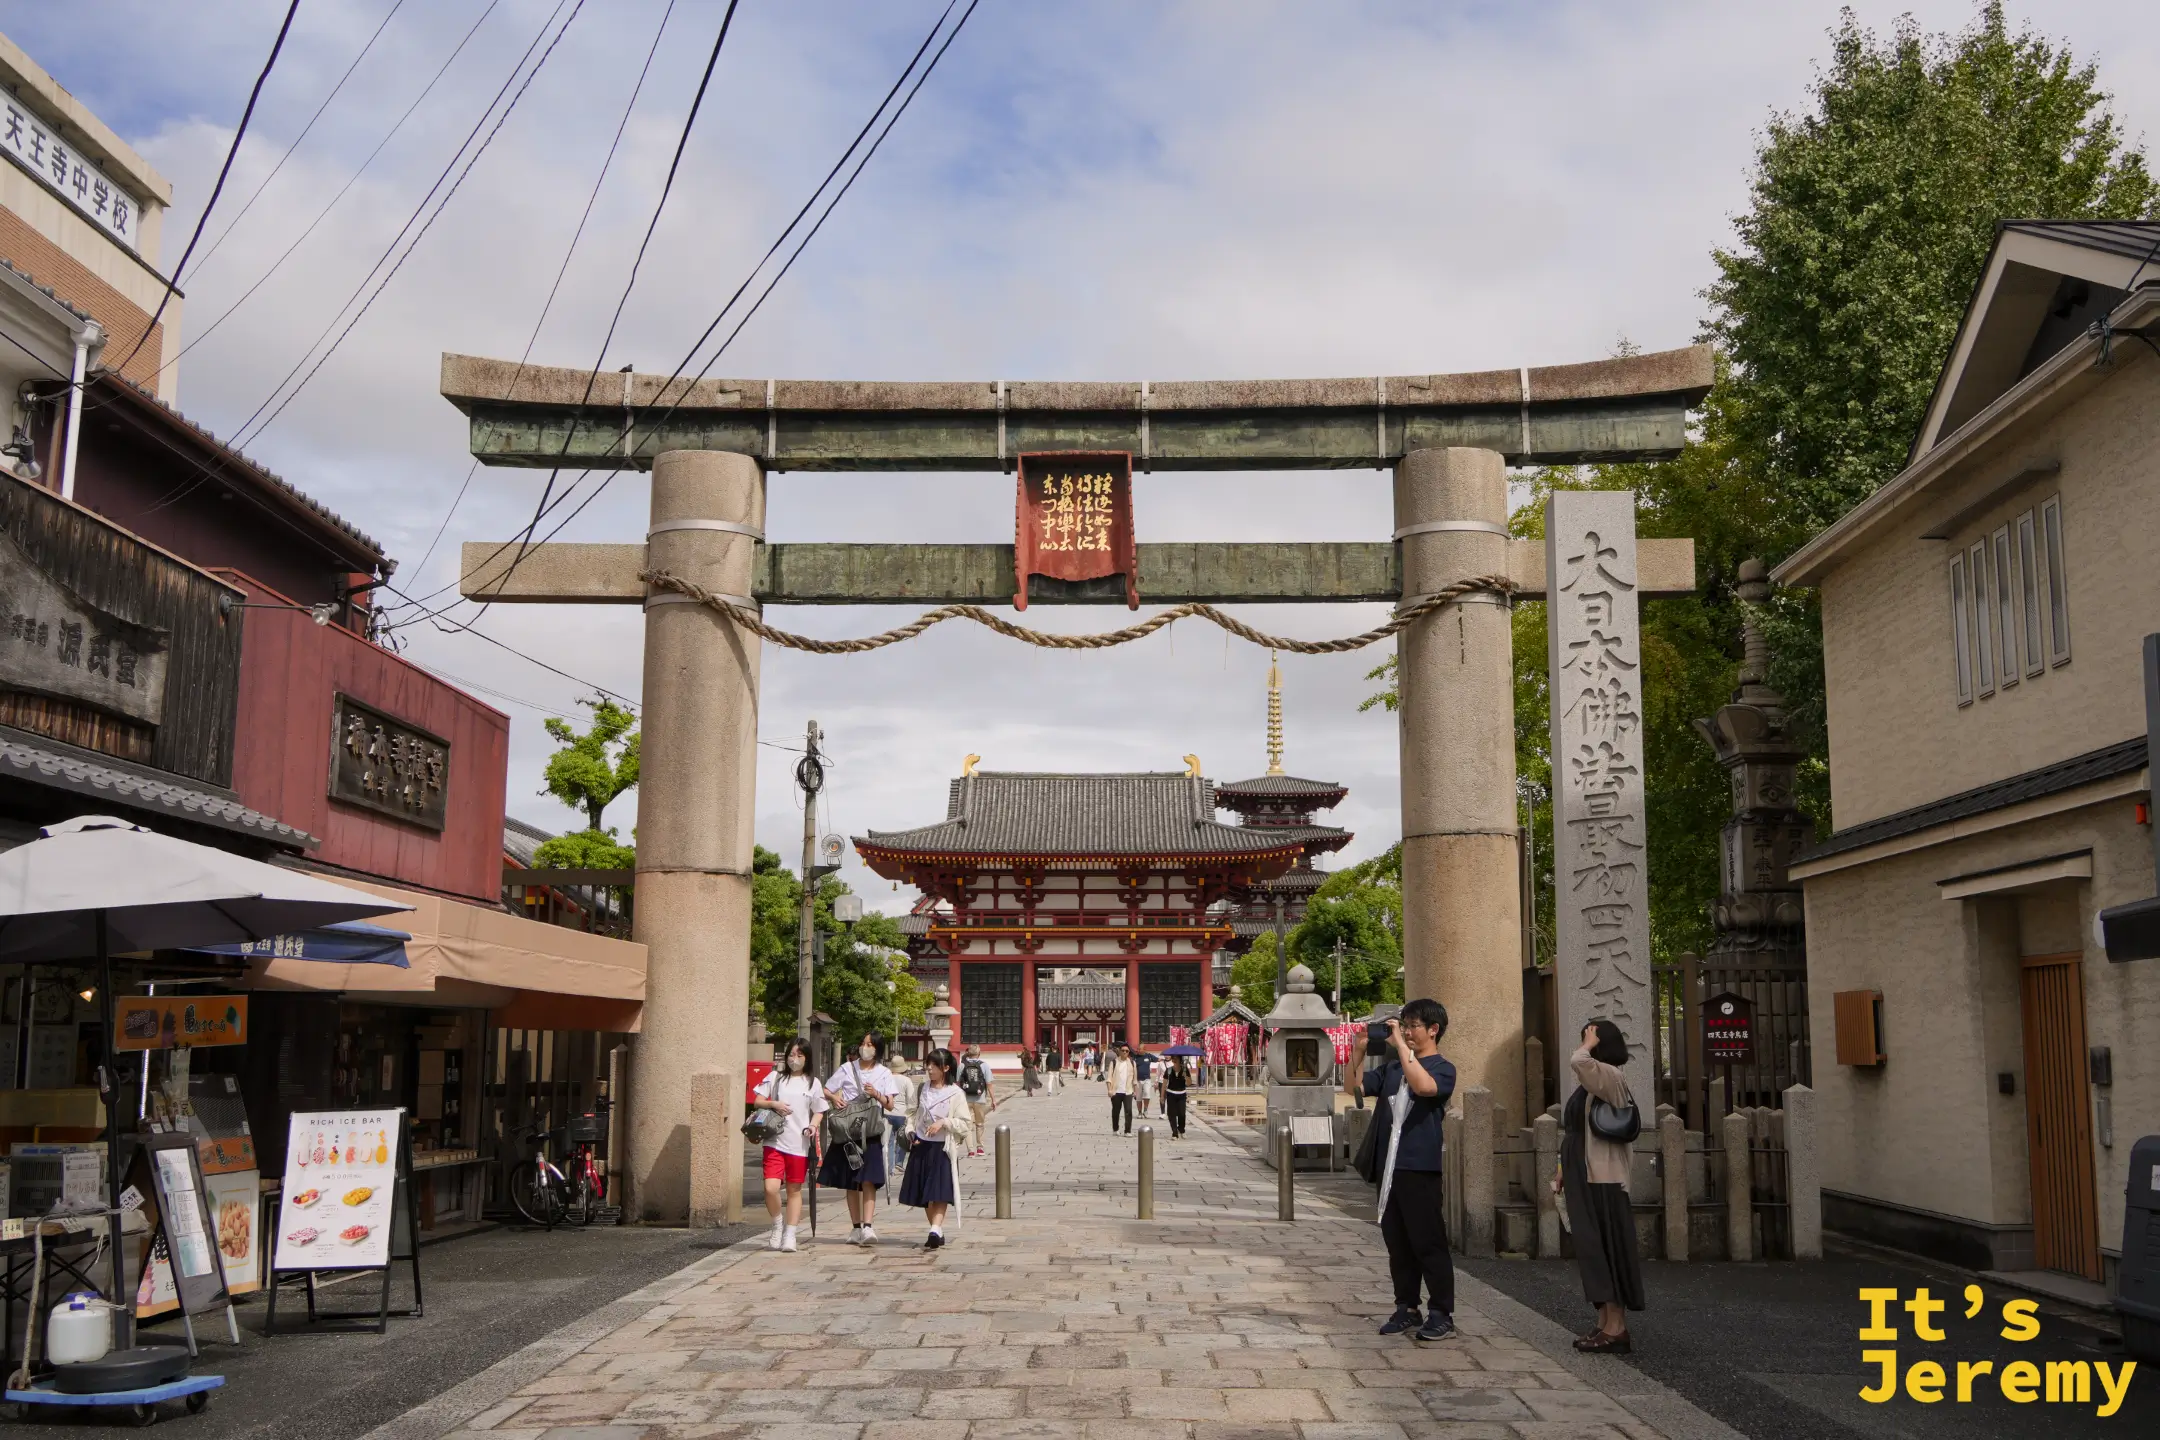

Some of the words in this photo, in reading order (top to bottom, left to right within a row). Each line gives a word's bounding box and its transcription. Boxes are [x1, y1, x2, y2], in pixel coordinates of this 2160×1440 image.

[5, 104, 129, 236] 天王寺中学校
[1559, 531, 1648, 1070] 大日本佛法最初四天王
